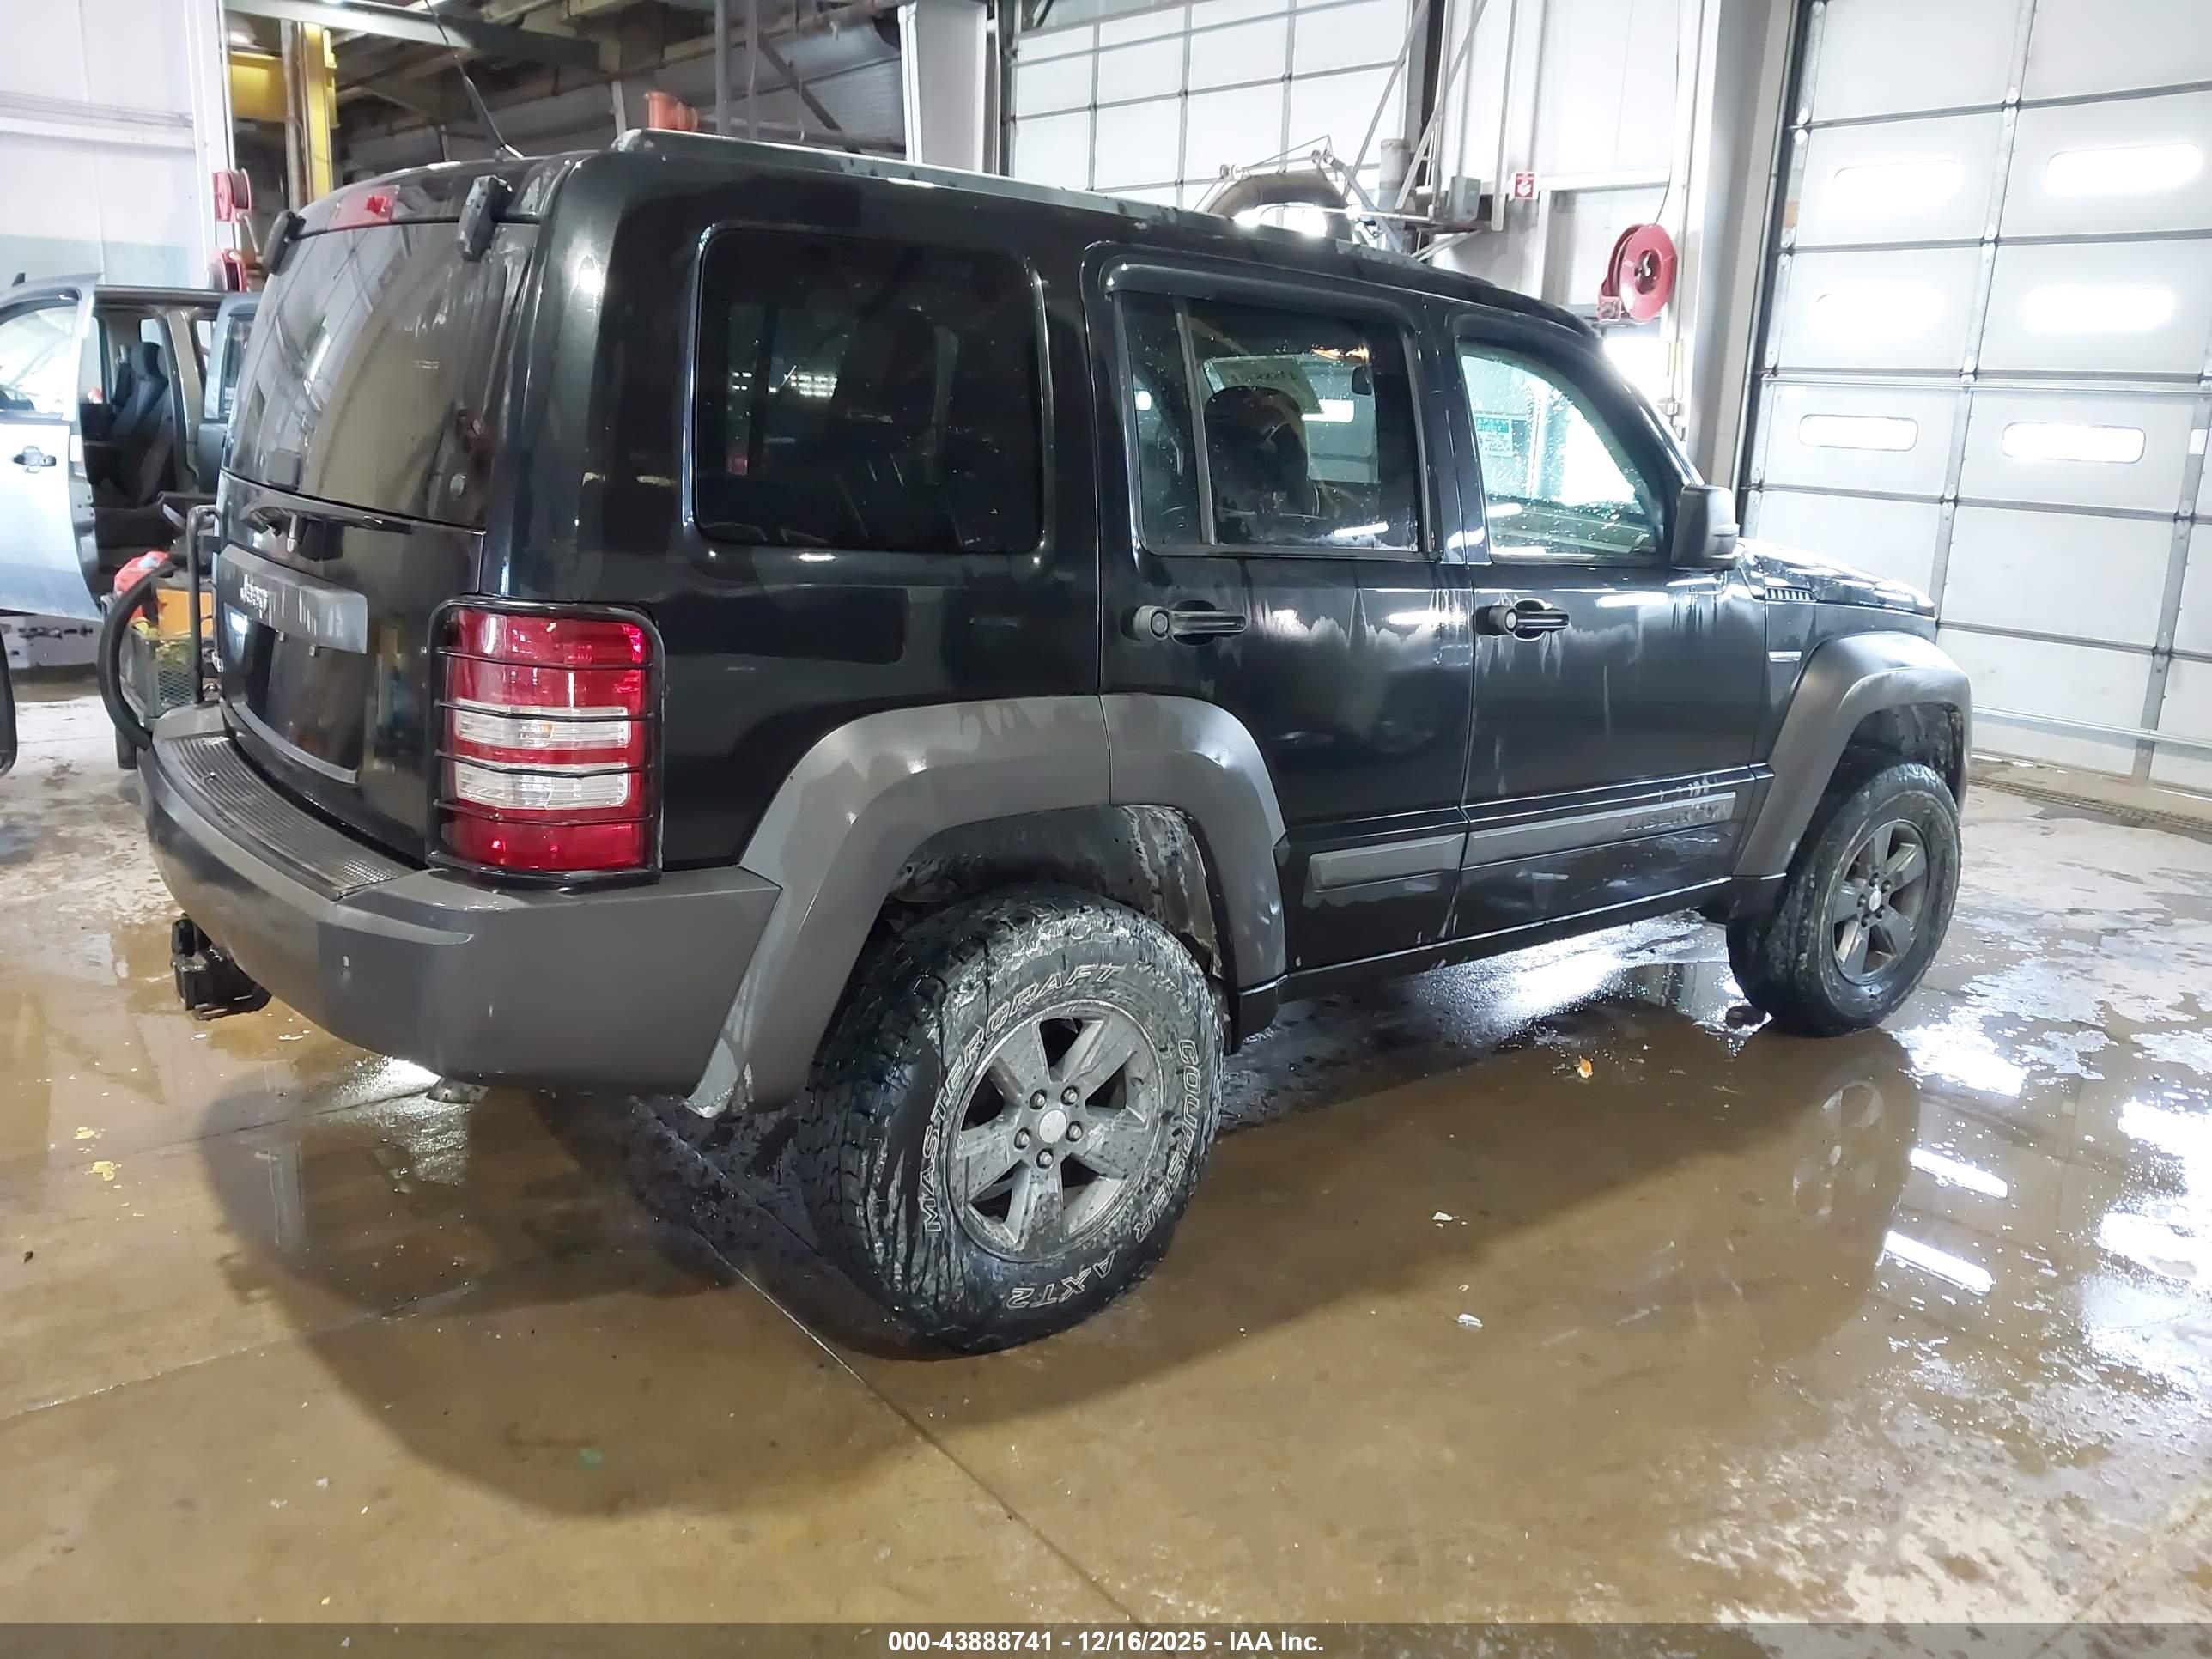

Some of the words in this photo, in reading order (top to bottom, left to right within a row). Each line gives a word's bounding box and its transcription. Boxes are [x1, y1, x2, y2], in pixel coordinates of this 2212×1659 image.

[919, 963, 1126, 1233] MASTERCRAFT
[1133, 1038, 1202, 1243] COURSER
[1006, 1250, 1117, 1310] AXT2
